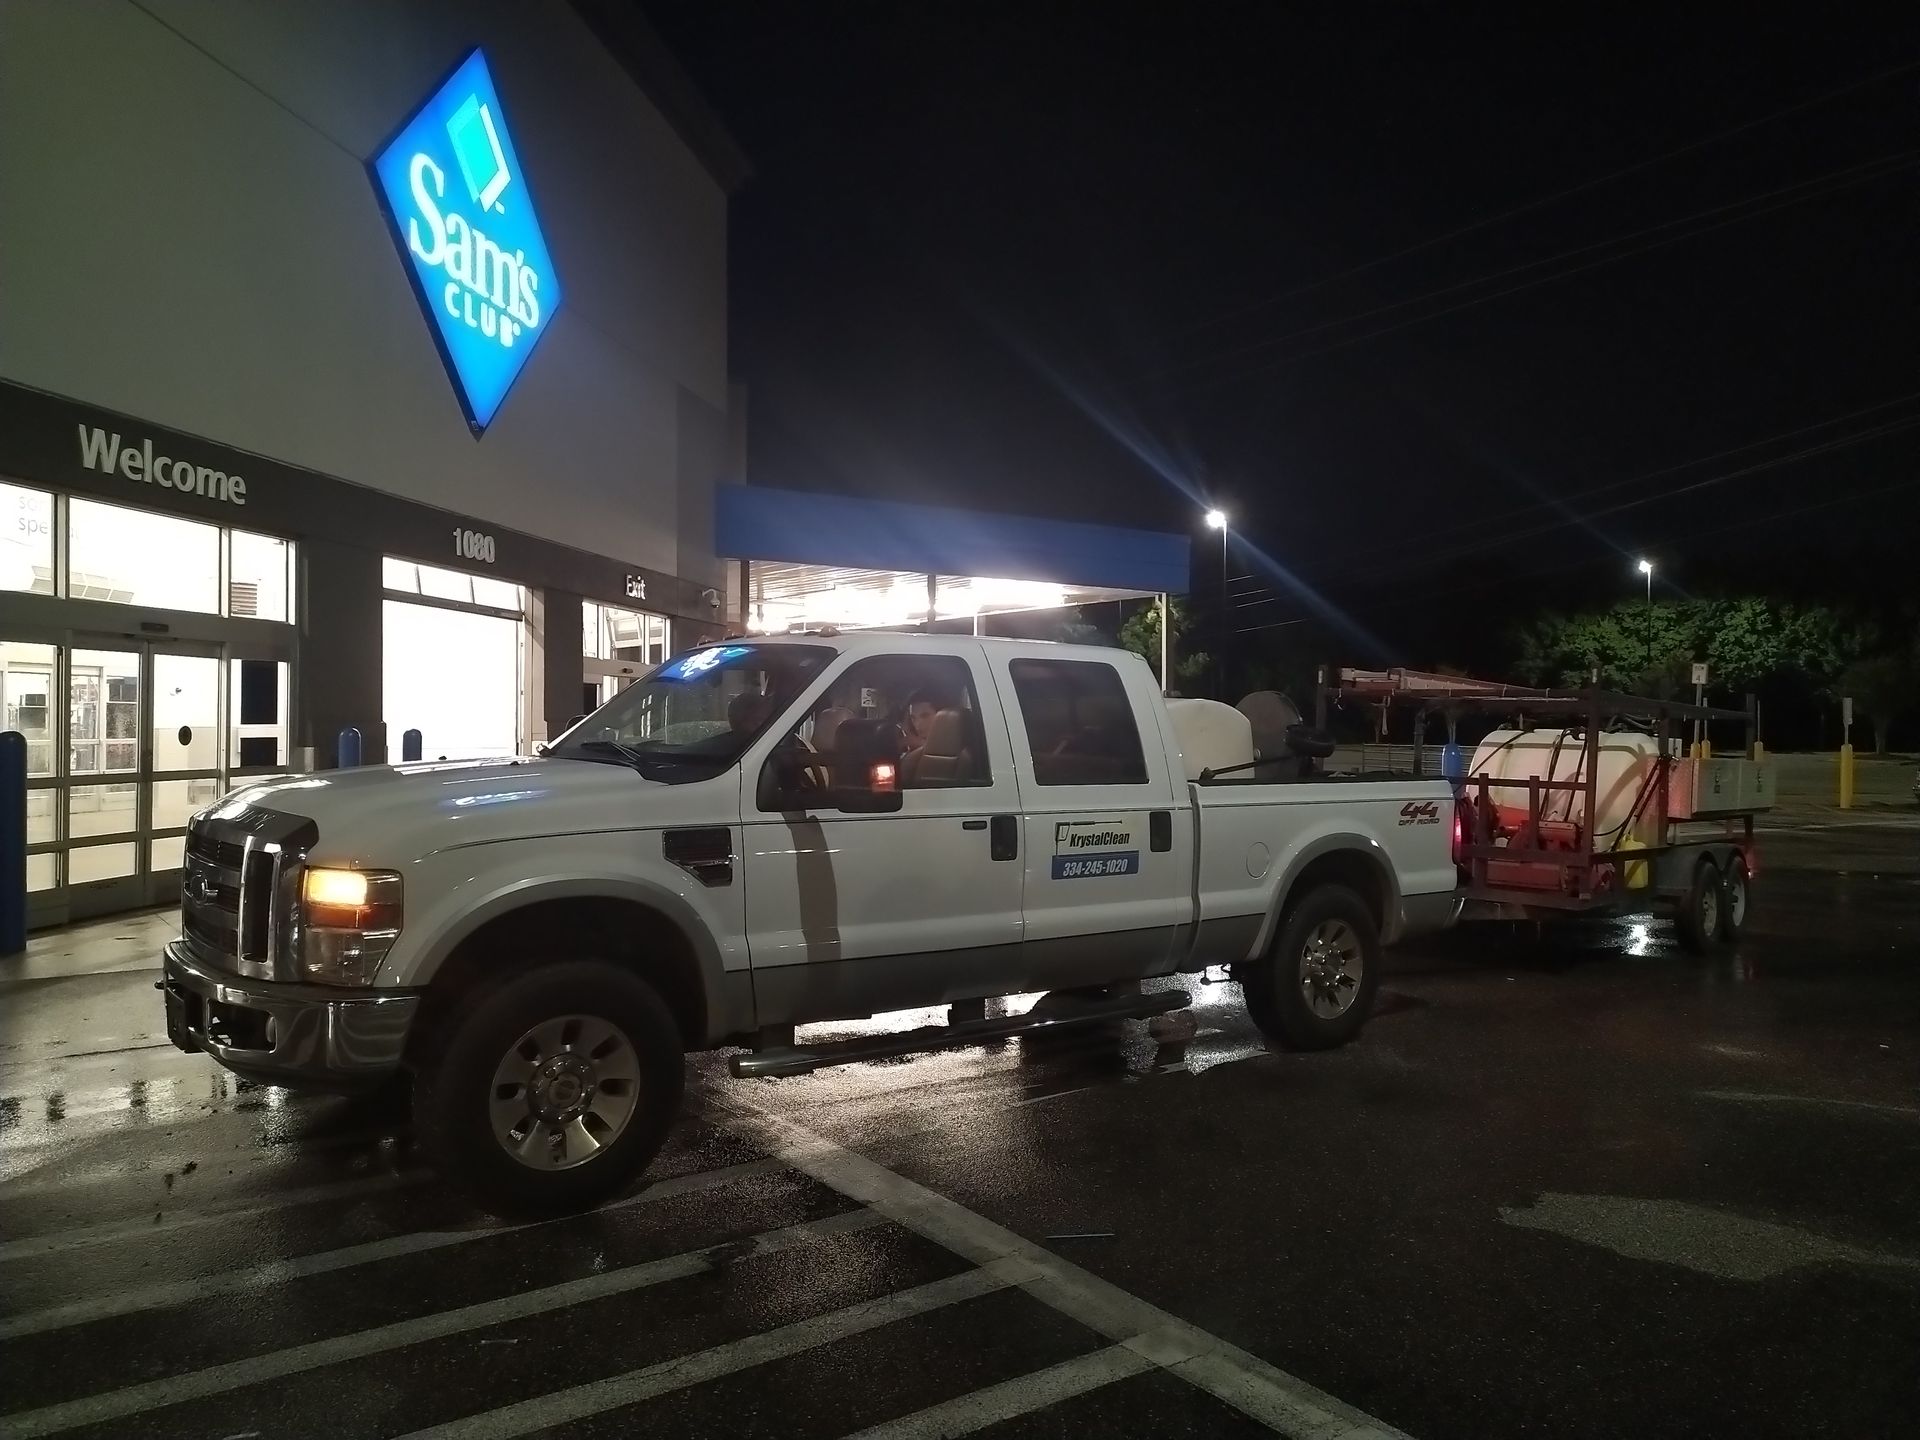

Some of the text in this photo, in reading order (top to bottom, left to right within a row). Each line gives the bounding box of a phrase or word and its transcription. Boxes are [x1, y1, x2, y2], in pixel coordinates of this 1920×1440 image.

[410, 153, 539, 328] Sam's
[79, 424, 246, 505] Welcome
[453, 528, 495, 563] 1080
[626, 575, 645, 600] Exit
[1400, 801, 1439, 818] 4x4
[1069, 832, 1130, 848] KrystalClean
[1062, 859, 1128, 876] 334-245-1020
